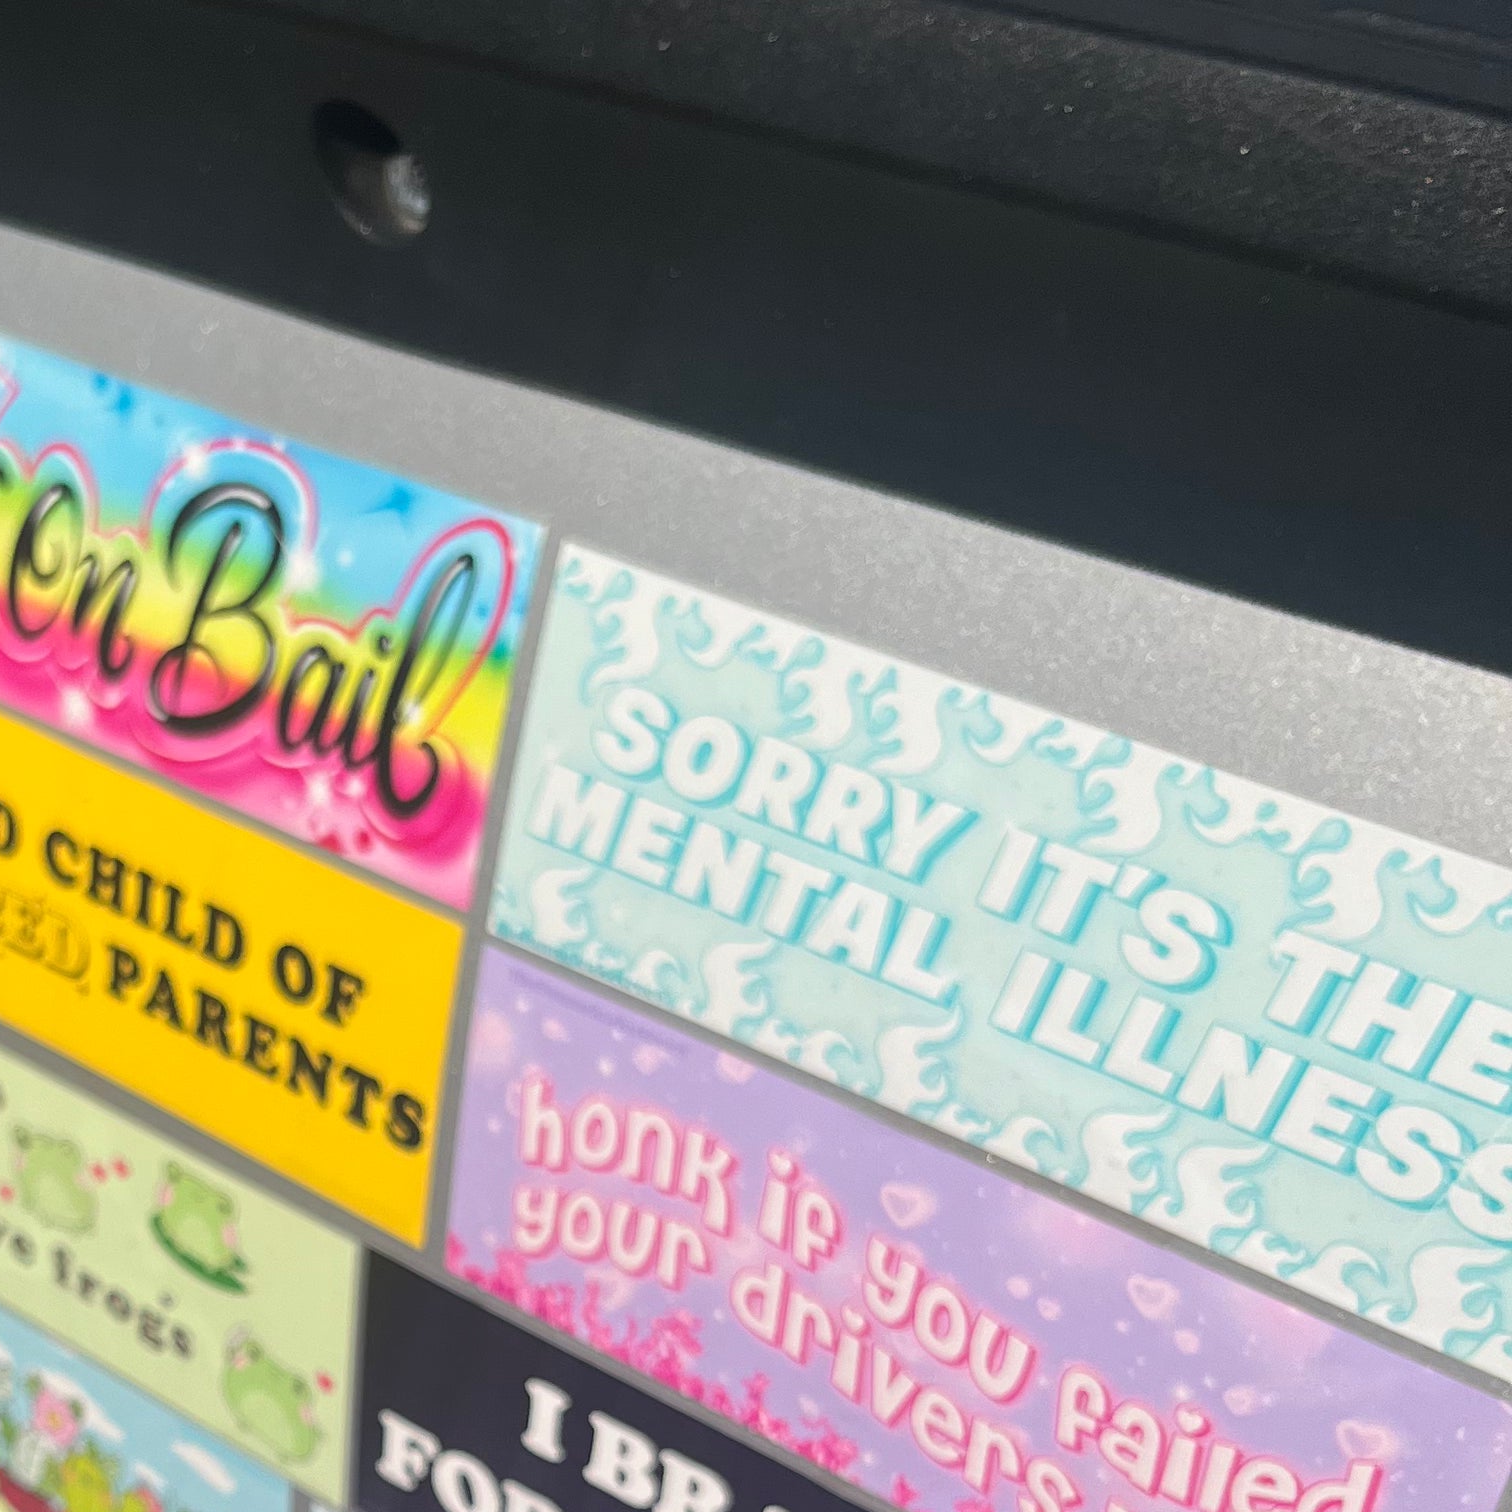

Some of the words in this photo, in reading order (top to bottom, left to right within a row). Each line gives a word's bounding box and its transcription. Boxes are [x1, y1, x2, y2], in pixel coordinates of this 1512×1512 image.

[7, 480, 138, 682] On
[148, 480, 478, 818] Bail
[43, 827, 248, 971] CHILD
[270, 941, 368, 1029] OF
[529, 763, 957, 1003] MENTAL
[594, 686, 980, 884] SORRY
[974, 819, 1235, 994] IT'S
[1264, 927, 1512, 1115] THE
[104, 941, 427, 1154] PARENTS
[51, 1244, 194, 1362] frogs
[510, 1181, 710, 1289] your
[518, 1071, 737, 1236] honk
[757, 1150, 842, 1272] if
[860, 1230, 1039, 1409] you
[521, 1376, 572, 1465] I
